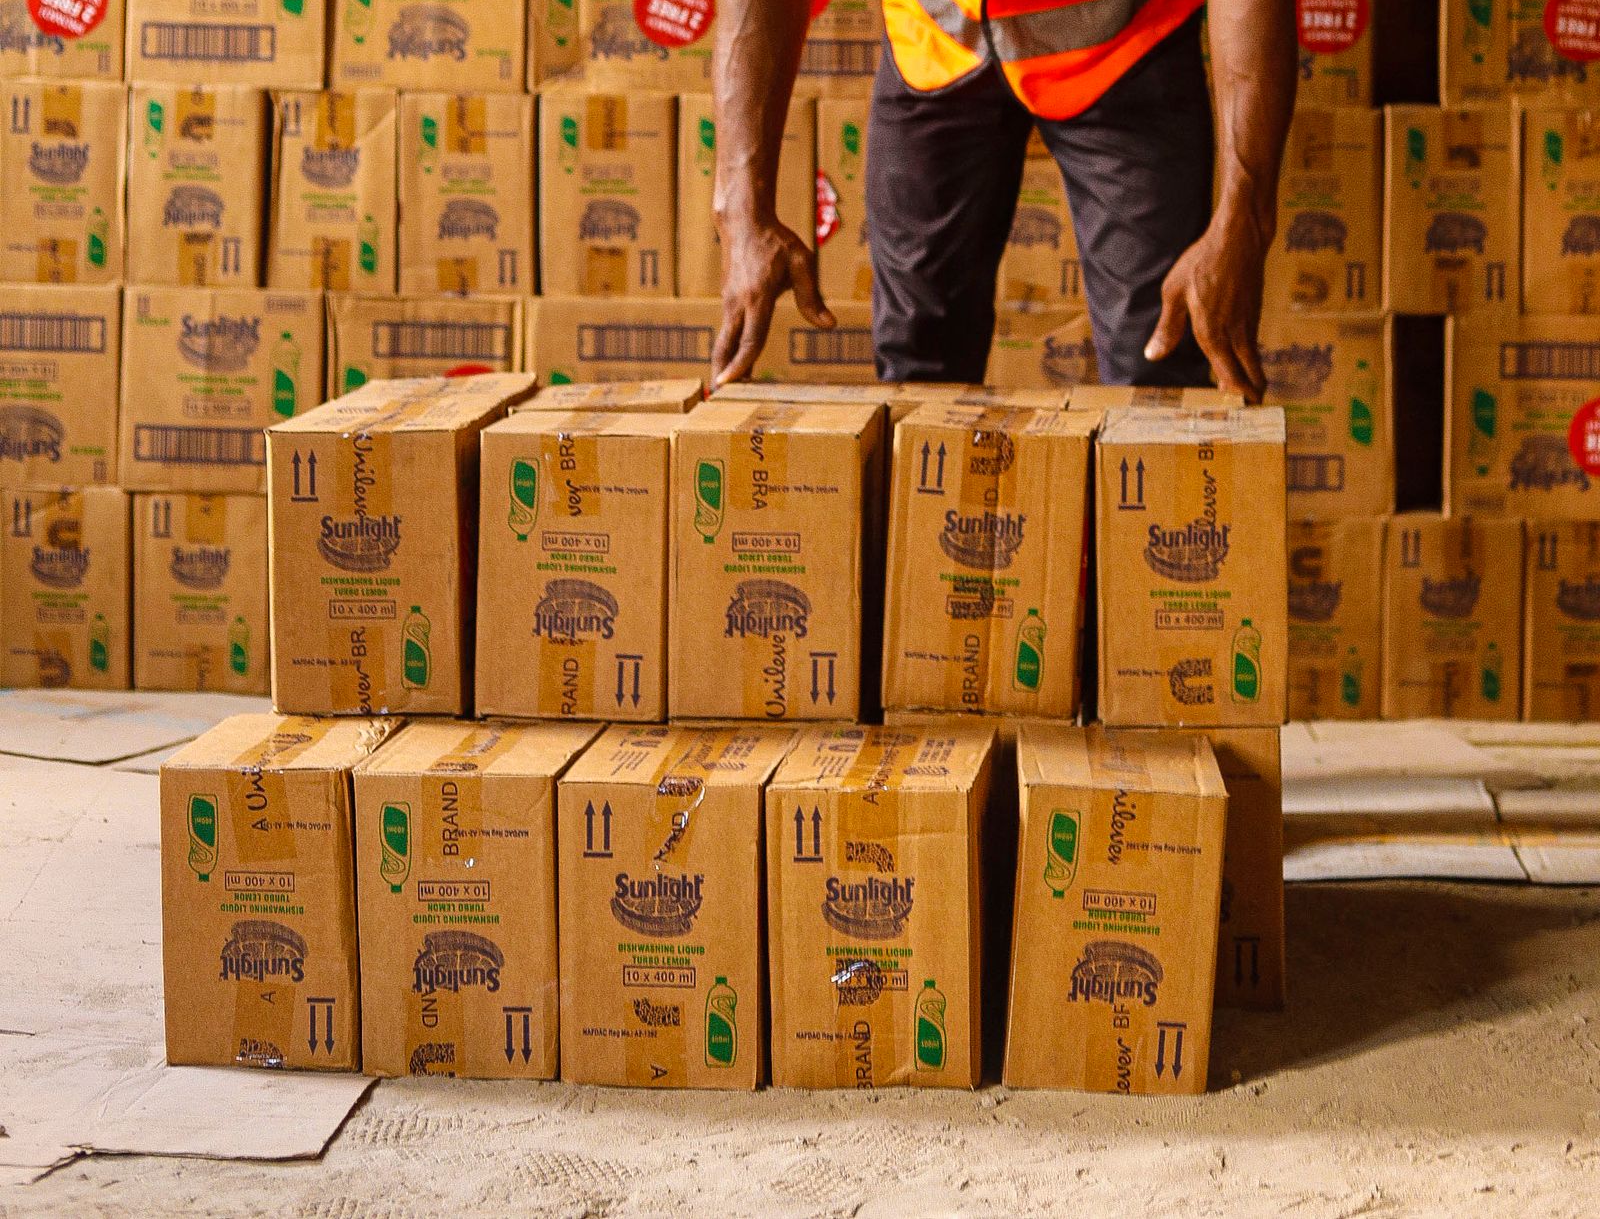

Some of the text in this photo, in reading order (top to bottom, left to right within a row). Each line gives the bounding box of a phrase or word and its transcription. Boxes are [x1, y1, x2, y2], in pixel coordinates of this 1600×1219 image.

[386, 34, 466, 61] Sunlight
[182, 314, 260, 338] Sunlight
[752, 470, 768, 510] BRA
[320, 514, 402, 543] Sunlight
[944, 509, 1028, 540] Sunlight
[544, 536, 606, 548] 10 x 400 ml
[734, 538, 798, 548] 10 x 400 ml
[1148, 524, 1232, 551] Sunlight
[550, 553, 604, 563] TURBO LEMON
[738, 554, 792, 562] TURBO LEMON
[536, 562, 617, 574] DISHWASHING LIQUID
[724, 564, 806, 574] DISHWASHING LIQUID
[321, 576, 400, 587] DISHWASHING LIQUID
[334, 588, 388, 597] TURBO LEMON
[1150, 590, 1232, 598] DISHWASHING LIQUID
[332, 604, 394, 615] 10 x 400 ml
[1164, 600, 1218, 610] TURBO LEMON
[532, 610, 615, 640] Sunlight
[724, 611, 808, 639] Sunlight
[1158, 614, 1171, 624] 10
[1184, 614, 1204, 624] 400
[1206, 614, 1222, 624] ml
[350, 626, 367, 657] BR
[962, 634, 980, 705] BRAND
[562, 658, 579, 715] RAND
[862, 792, 880, 806] A
[251, 817, 268, 832] A
[442, 782, 459, 857] BRAND
[227, 876, 292, 888] 10 x 400 ml
[614, 872, 705, 903] Sunlight
[234, 892, 290, 903] TURBO LEMON
[420, 886, 487, 896] 10 x 400 ml
[826, 876, 916, 906] Sunlight
[220, 904, 304, 914] DISHWASHING LIQUID
[428, 903, 486, 912] TURBO LEMON
[1086, 895, 1154, 910] 10 x 400 ml
[413, 914, 500, 924] DISHWASHING LIQUID
[1088, 908, 1146, 922] TURBO LEMON
[1072, 920, 1160, 936] DISHWASHING LIQUID
[618, 942, 706, 956] DISHWASHING LIQUID
[826, 946, 913, 958] DISHWASHING LIQUID
[219, 953, 304, 983] Sunlight
[632, 956, 691, 966] TURBO LEMON
[412, 964, 501, 994] Sunlight
[626, 971, 694, 984] 10 x 400 ml
[892, 975, 908, 987] ml
[260, 990, 276, 1005] A
[1067, 974, 1159, 1007] Sunlight
[582, 1028, 607, 1036] NAFDAC
[608, 1028, 620, 1038] Reg
[796, 1032, 820, 1040] NAFDAC
[650, 1064, 668, 1080] A
